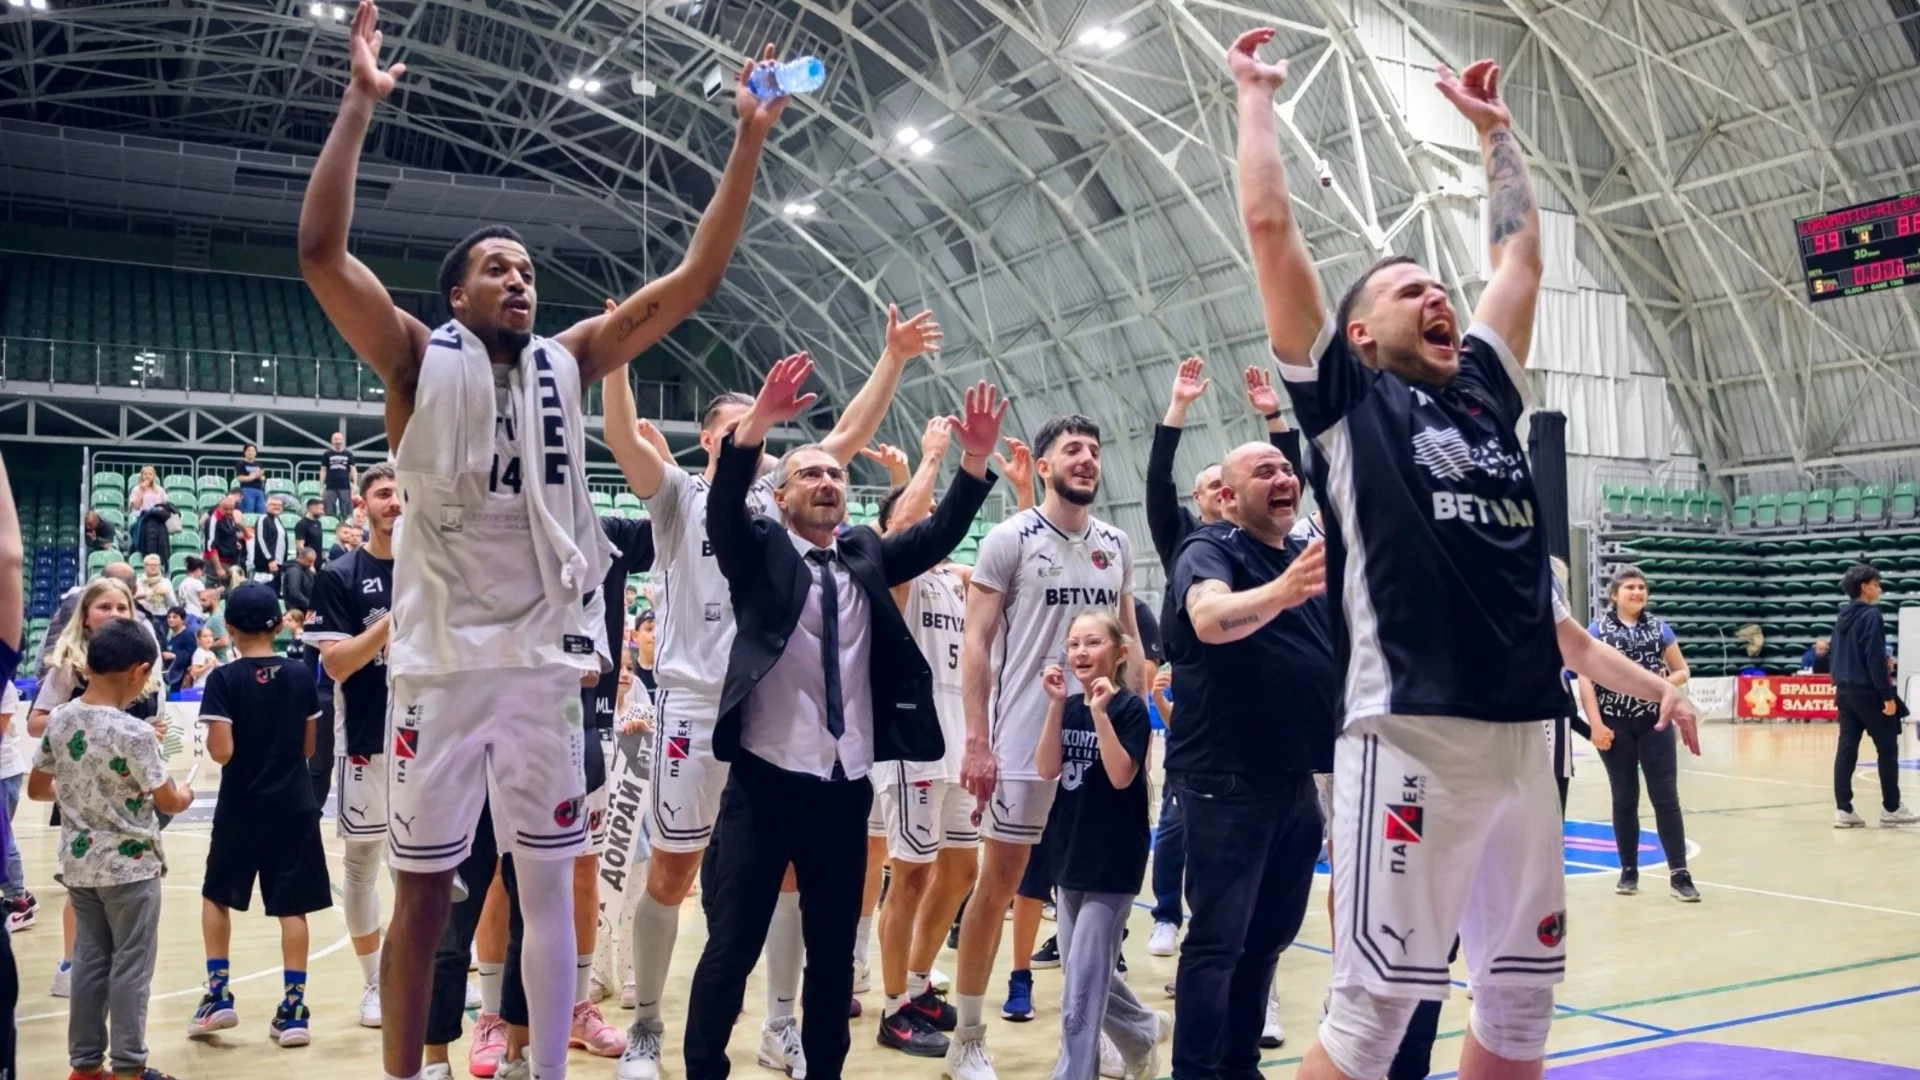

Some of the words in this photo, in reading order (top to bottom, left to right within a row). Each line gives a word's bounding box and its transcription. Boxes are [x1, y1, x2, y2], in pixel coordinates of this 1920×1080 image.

[1814, 231, 1840, 255] 99
[1859, 231, 1869, 244] 4
[489, 454, 522, 495] 14
[362, 577, 384, 594] 21
[1045, 587, 1118, 608] BETVAM
[948, 643, 959, 670] 5
[1782, 699, 1838, 711] ЗЛАТИ
[600, 779, 643, 893] ДОКРАЙ
